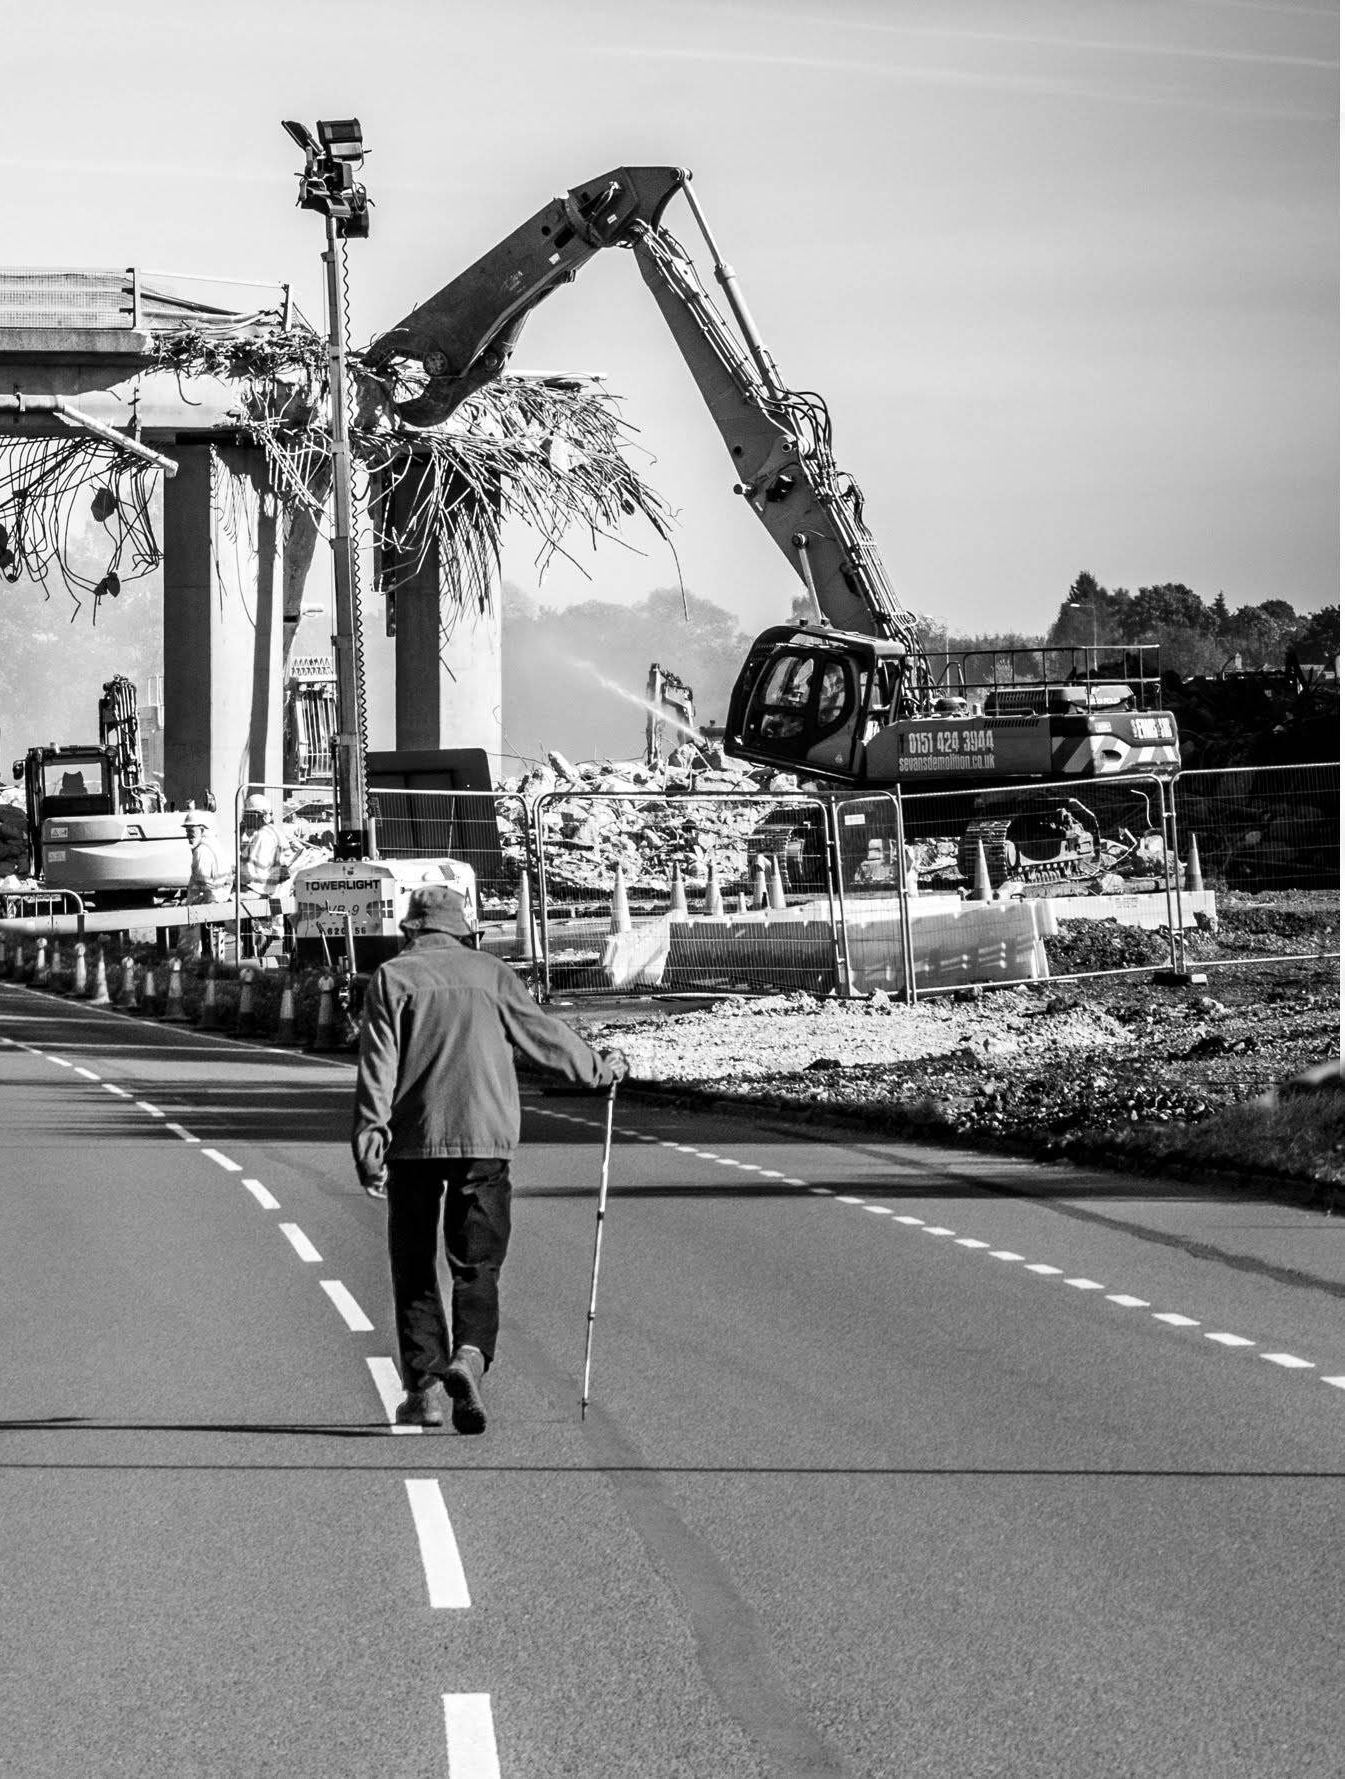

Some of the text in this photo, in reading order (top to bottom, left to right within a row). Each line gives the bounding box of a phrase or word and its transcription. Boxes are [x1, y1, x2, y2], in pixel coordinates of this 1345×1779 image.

[908, 732, 933, 753] 0151
[937, 731, 960, 752] 424
[962, 730, 994, 752] 3944
[899, 753, 995, 772] sevansdemolition.co.uk
[305, 879, 381, 891] TOWERLIGHT
